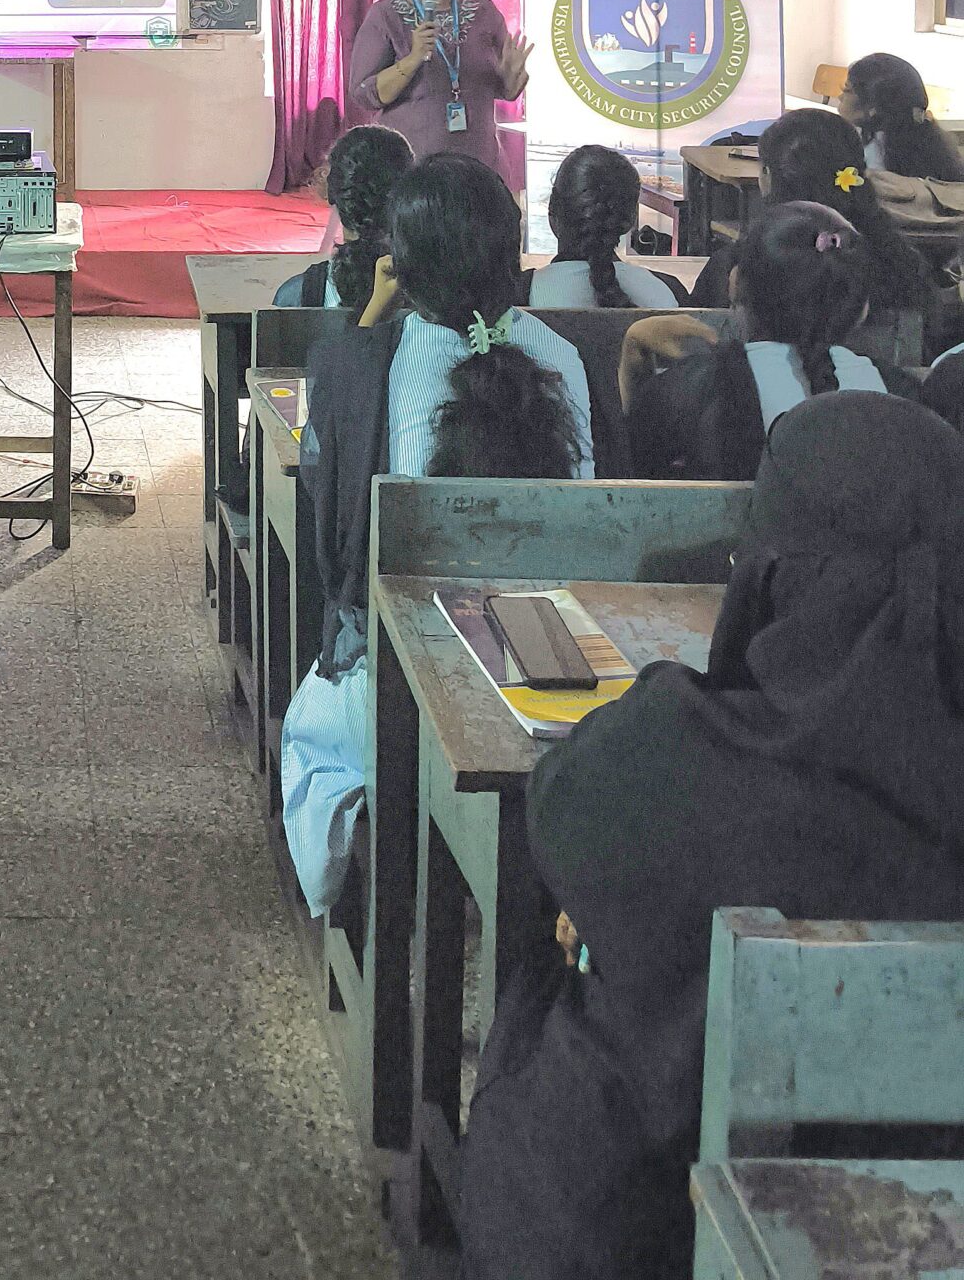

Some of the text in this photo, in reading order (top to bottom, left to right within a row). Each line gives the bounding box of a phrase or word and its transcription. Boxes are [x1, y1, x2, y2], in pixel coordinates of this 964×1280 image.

[554, 5, 745, 124] VISAKHAPATNAM CITY SECURITY COUNCIL
